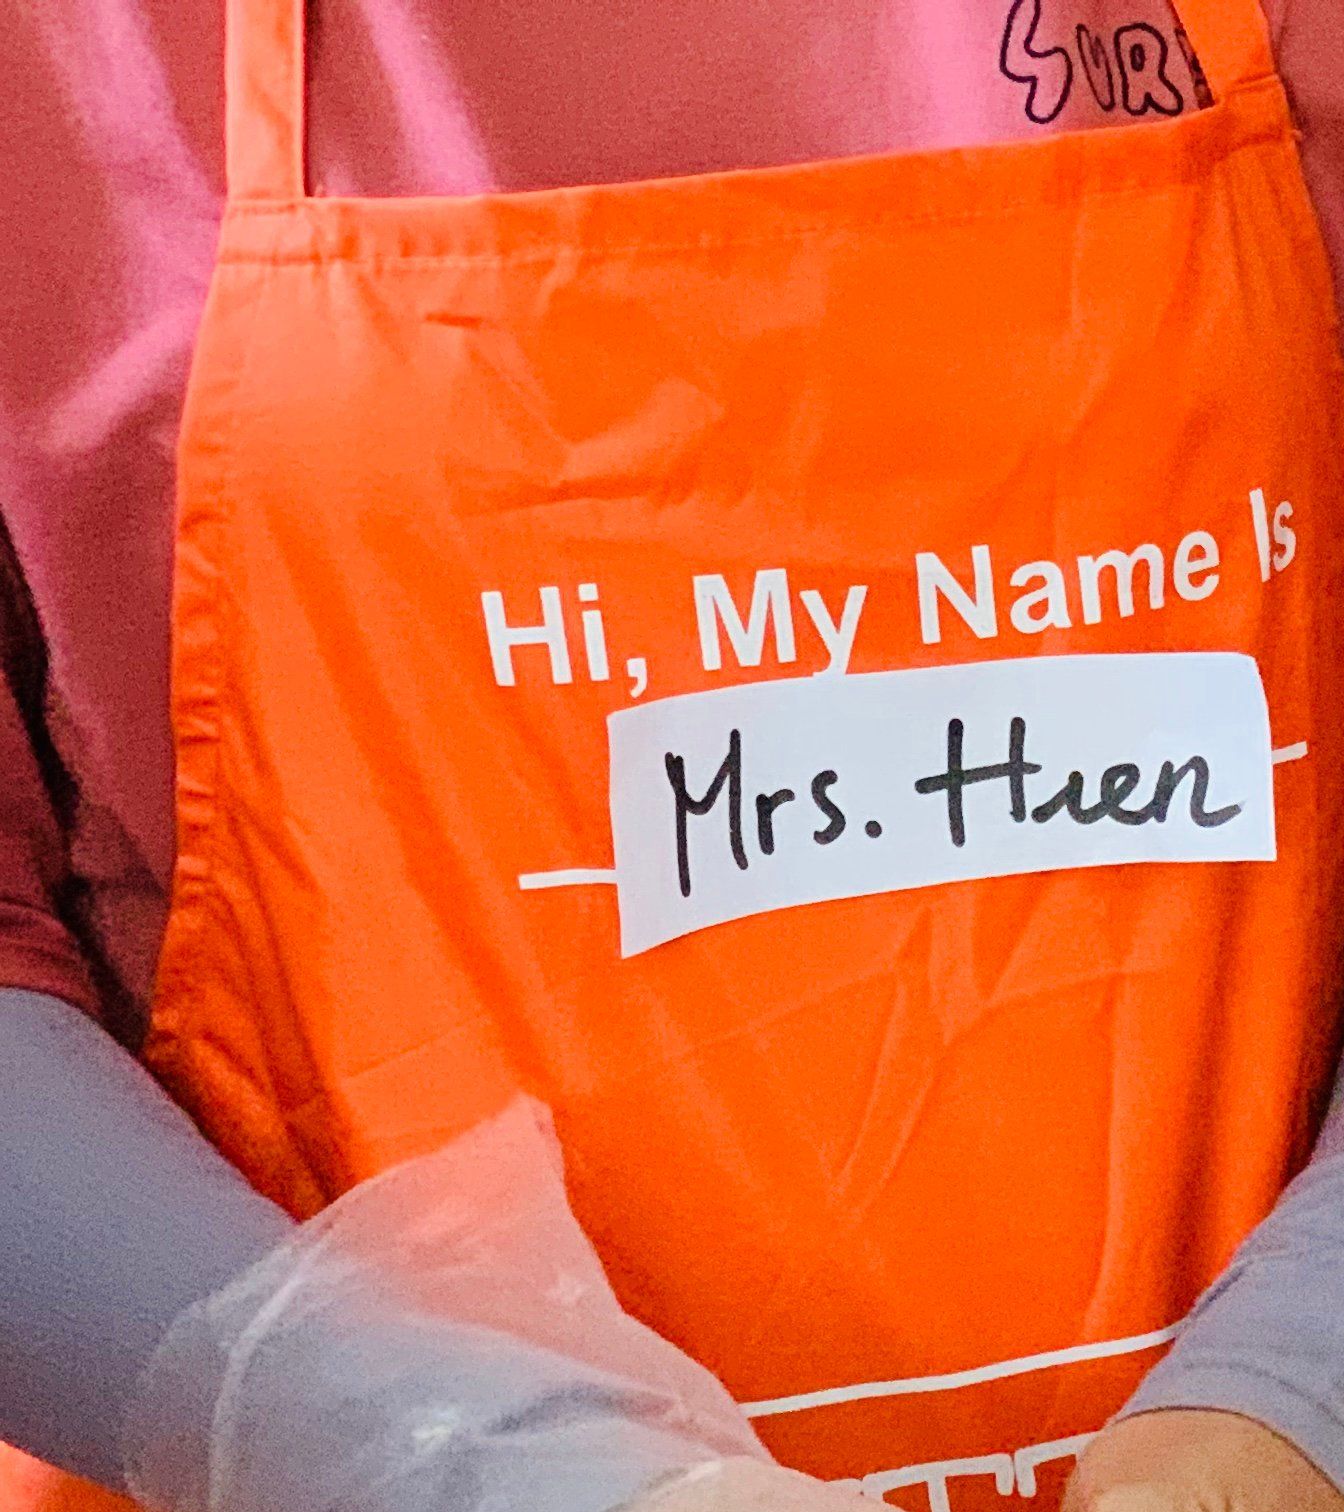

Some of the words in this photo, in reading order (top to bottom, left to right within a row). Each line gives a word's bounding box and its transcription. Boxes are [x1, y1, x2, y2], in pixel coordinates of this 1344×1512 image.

[481, 582, 648, 698] Hi,
[693, 567, 868, 676] My
[915, 530, 1220, 644] Name
[1249, 487, 1297, 583] Is
[664, 728, 883, 897] Mrs.
